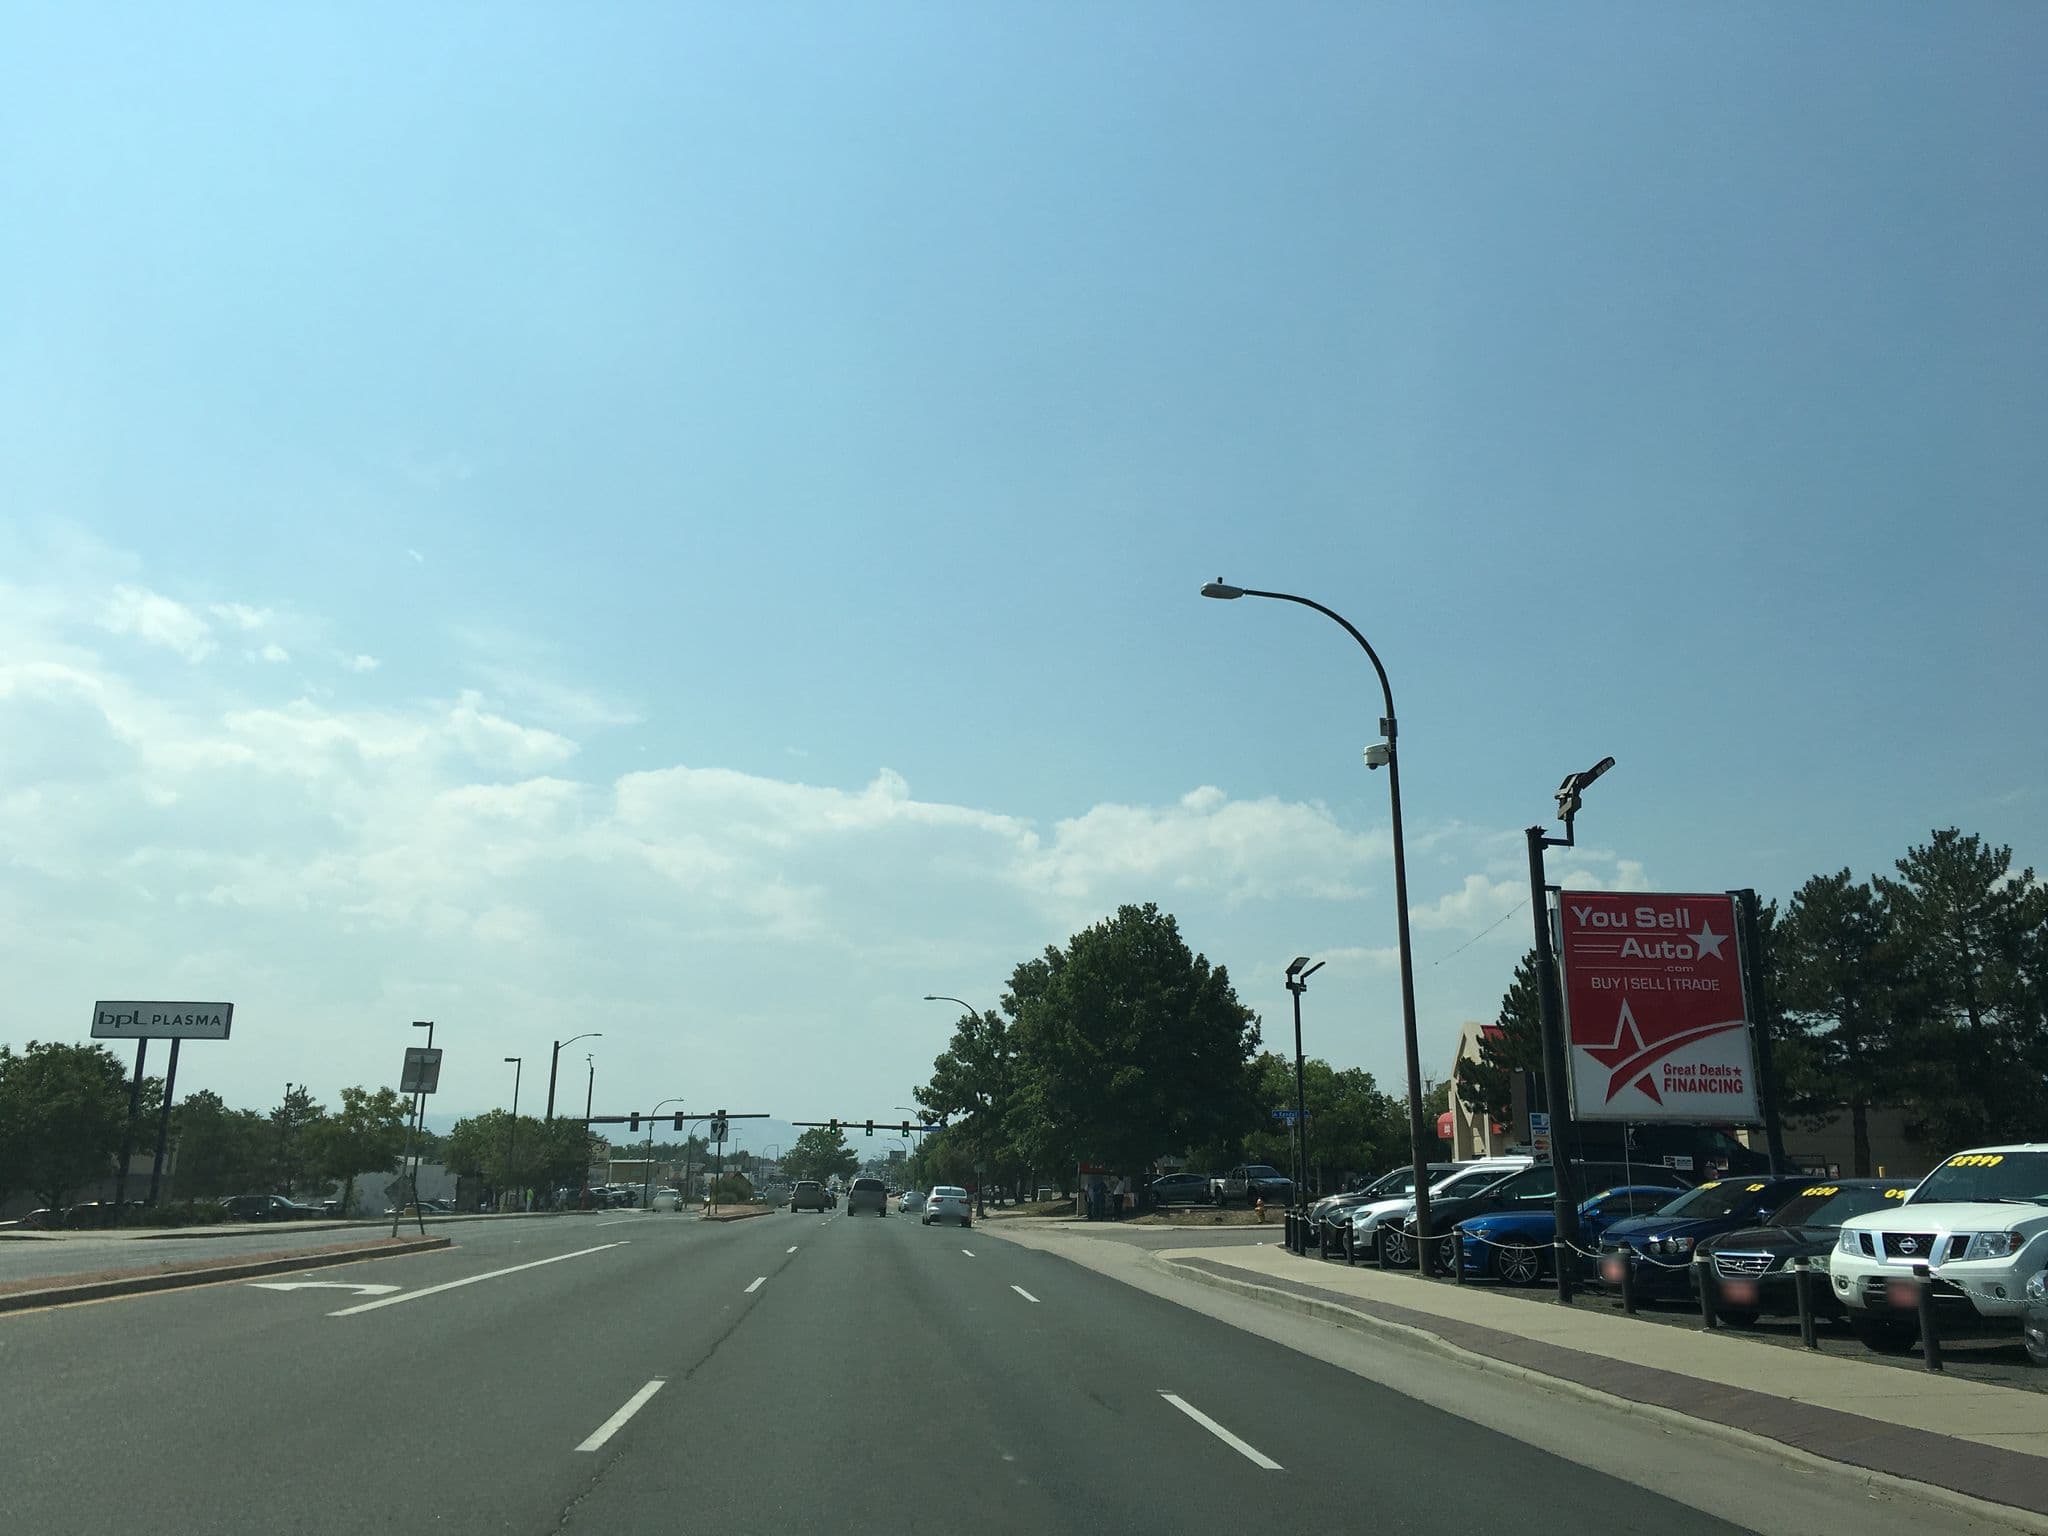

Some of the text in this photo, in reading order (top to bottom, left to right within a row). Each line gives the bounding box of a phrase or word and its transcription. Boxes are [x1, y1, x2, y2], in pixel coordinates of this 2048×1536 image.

[1570, 905, 1691, 929] You Sell
[1620, 937, 1694, 960] Auto
[1664, 965, 1694, 973] .com
[1591, 977, 1720, 991] BUY SELL TRADE
[152, 1014, 221, 1026] PLASMA
[1663, 1063, 1732, 1077] Great Deals
[1663, 1078, 1744, 1094] FINANCING
